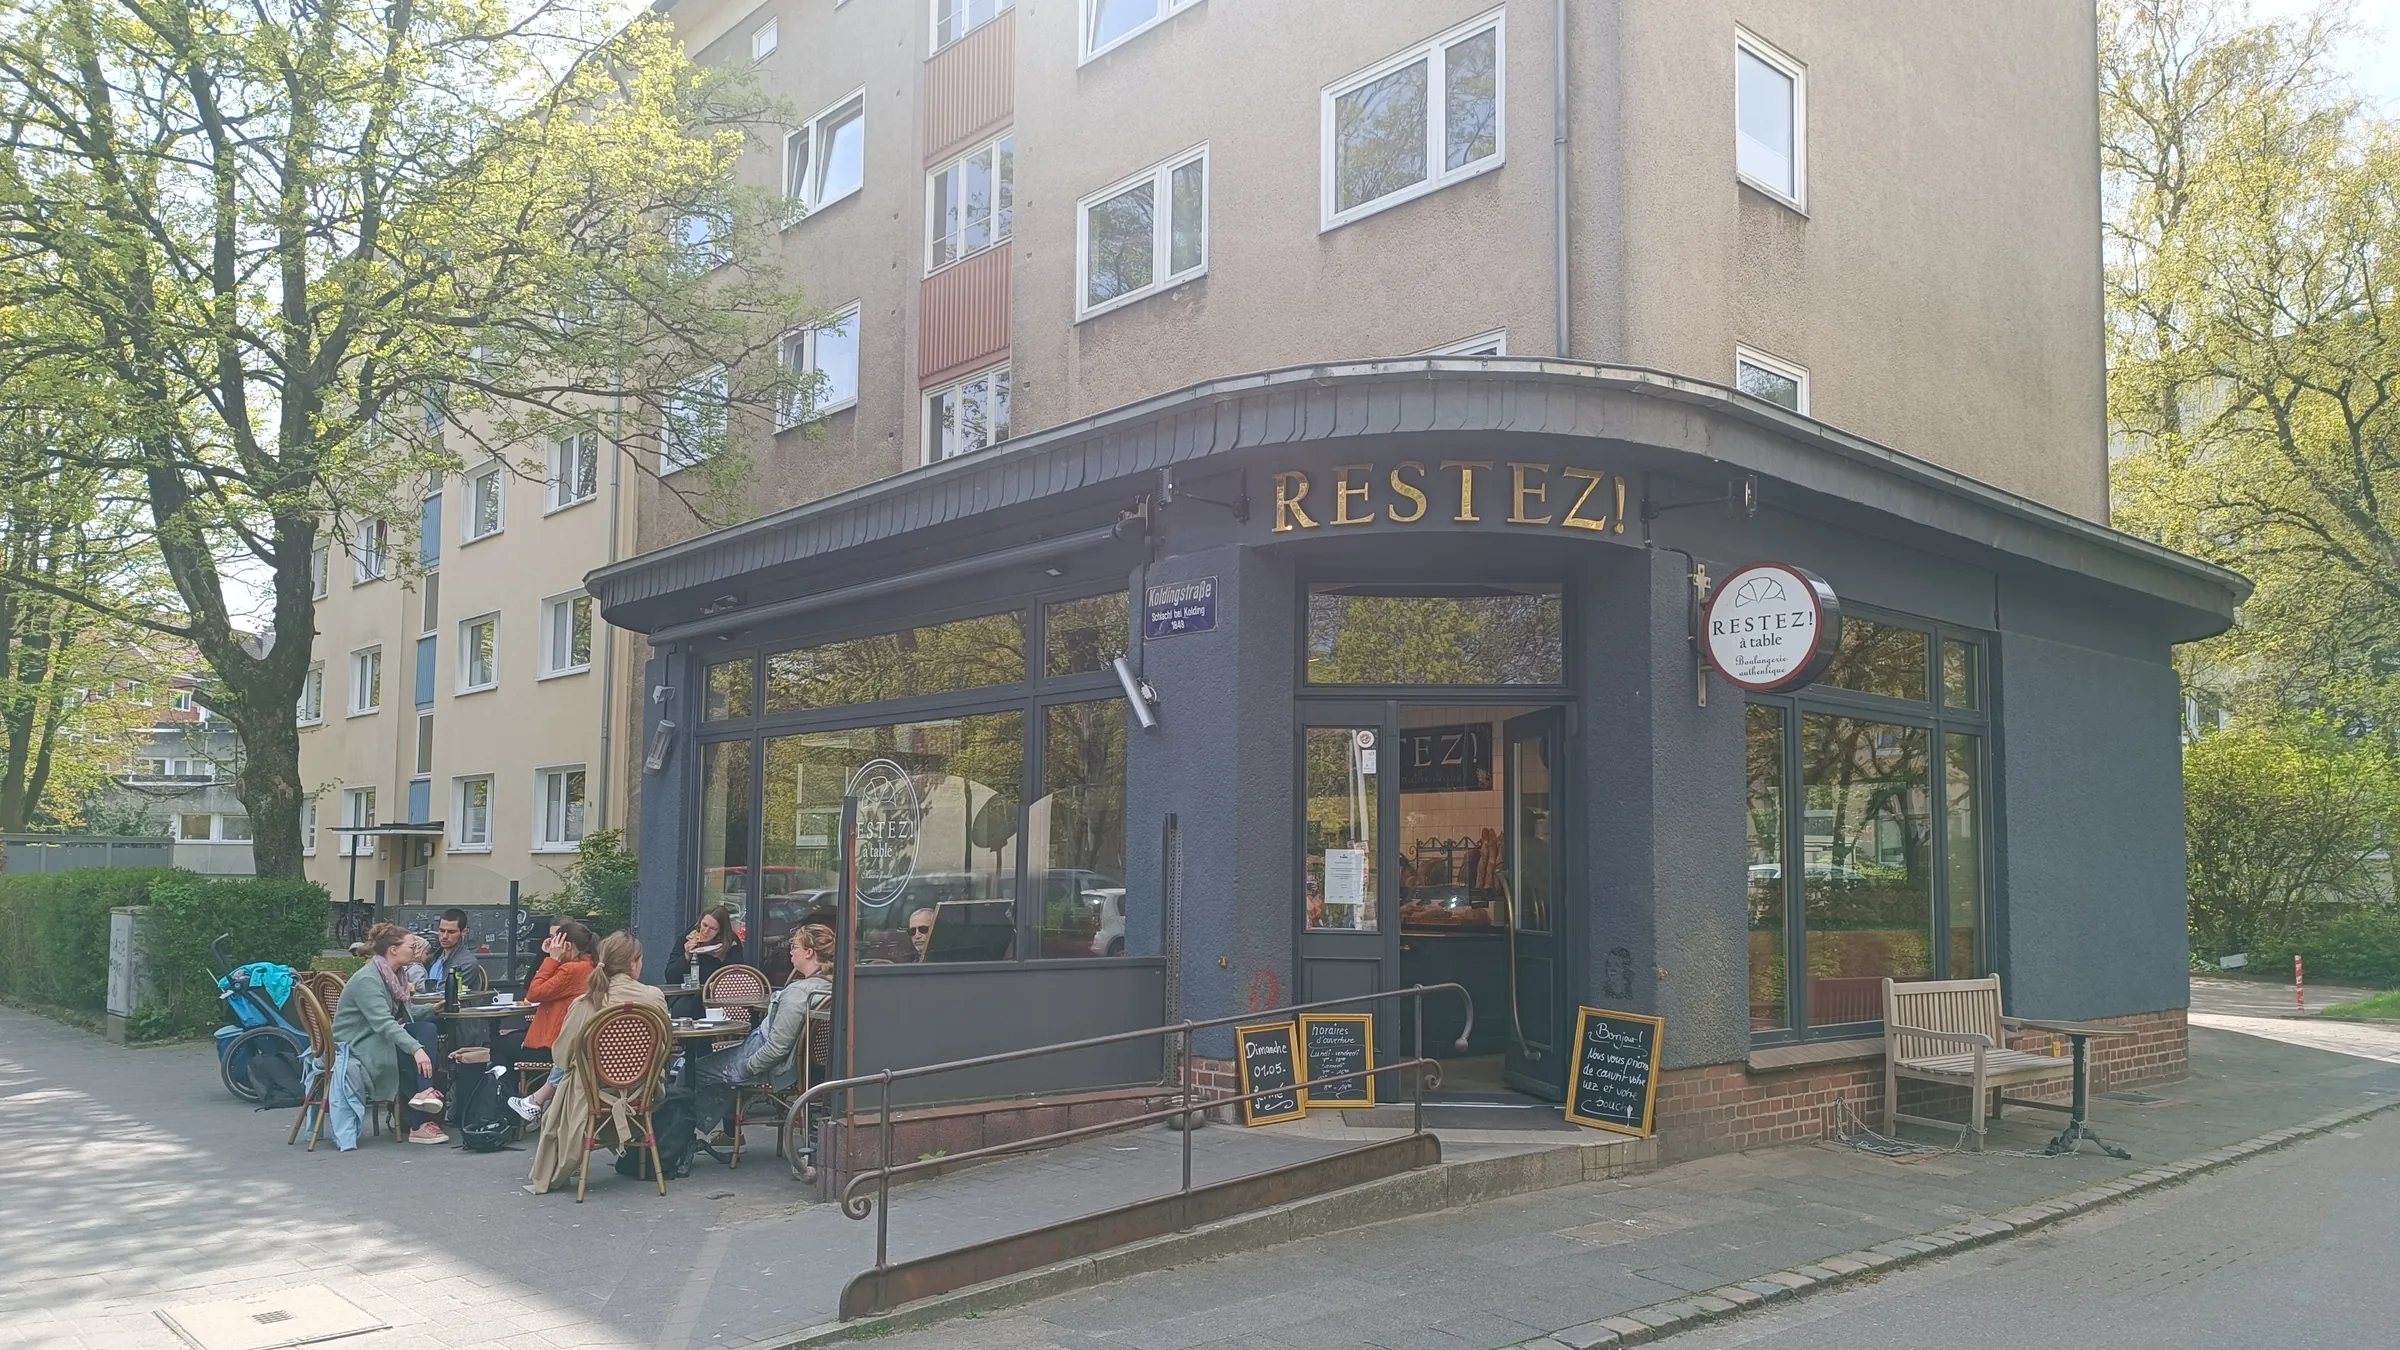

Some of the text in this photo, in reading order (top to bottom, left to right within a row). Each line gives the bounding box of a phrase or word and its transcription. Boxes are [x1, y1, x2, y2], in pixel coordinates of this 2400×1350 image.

[1271, 460, 1627, 534] RESTEZ!
[1148, 580, 1212, 607] Koldingstraße
[1173, 609, 1182, 618] bei
[1183, 606, 1205, 617] Kolding
[1712, 611, 1813, 636] RESTEZ!
[1739, 633, 1782, 648] à table
[1735, 654, 1788, 667] Boulangerie
[1738, 666, 1787, 677] authentique
[1400, 732, 1478, 768] EZ!
[856, 820, 914, 840] ESTEZ!
[870, 843, 892, 858] table
[1311, 1022, 1349, 1036] horaires
[1595, 1022, 1643, 1050] Bonjour!
[1245, 1040, 1288, 1059] Dimanche
[1587, 1047, 1605, 1061] Nous
[1606, 1054, 1625, 1065] vous
[1582, 1063, 1594, 1077] de
[1629, 1073, 1646, 1087] votre
[1603, 1084, 1614, 1093] et
[1595, 1095, 1633, 1113] bouch
